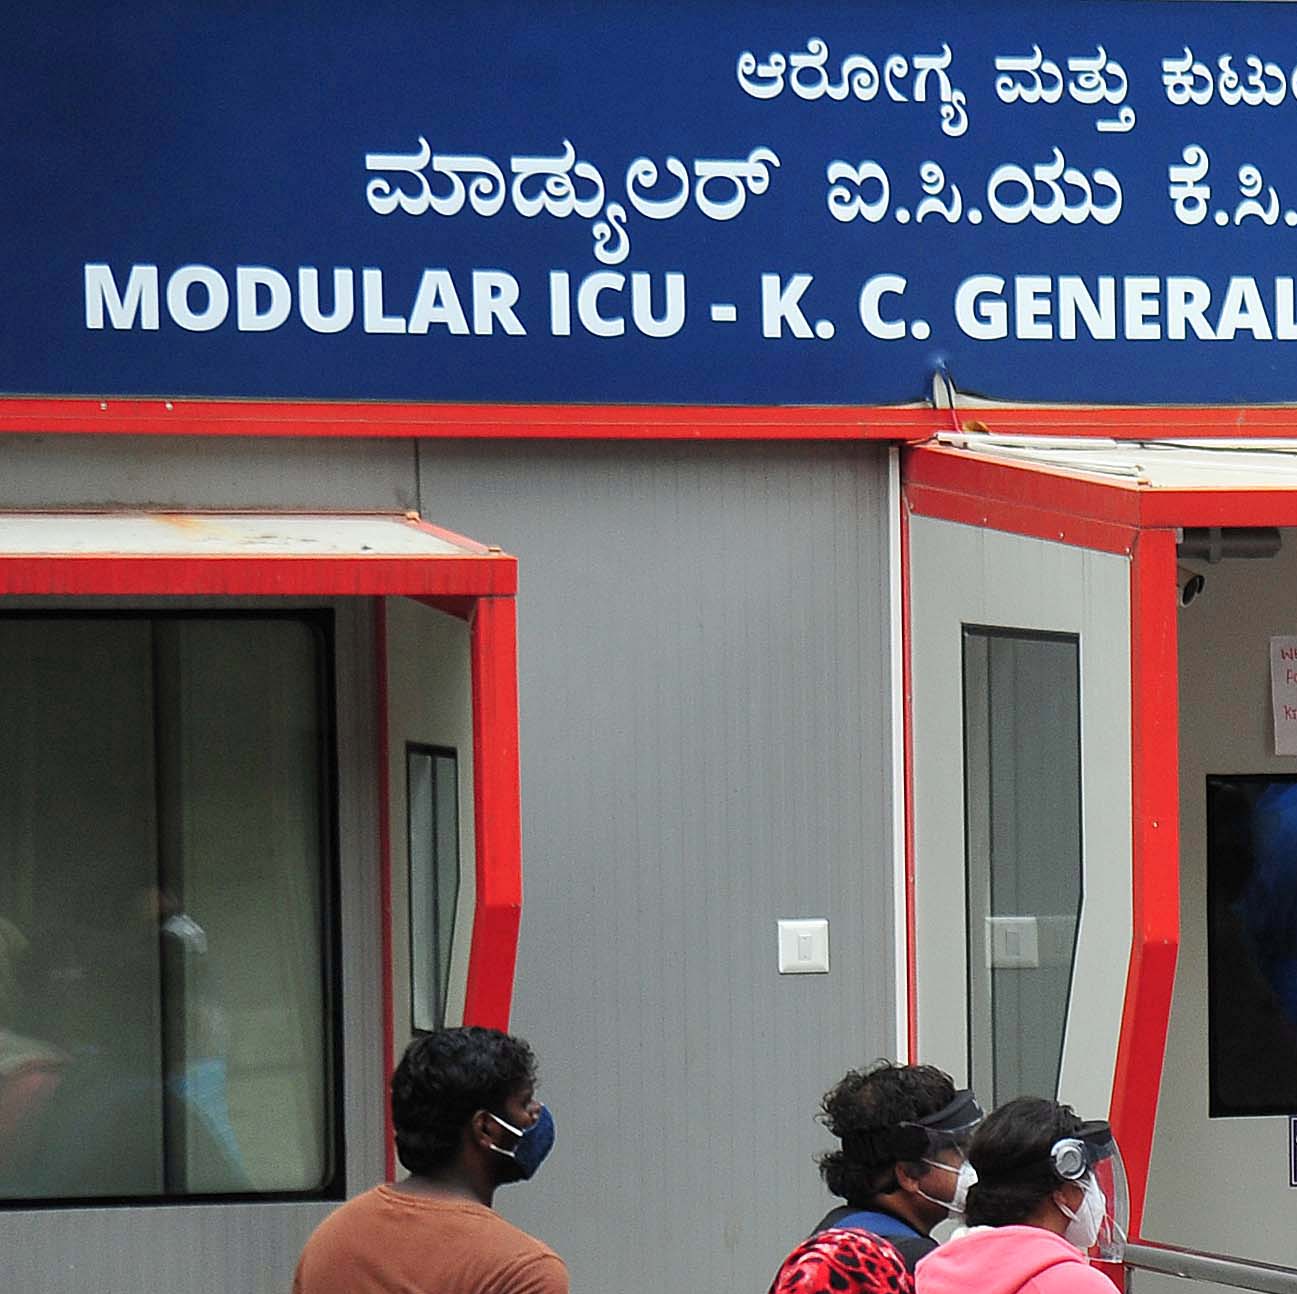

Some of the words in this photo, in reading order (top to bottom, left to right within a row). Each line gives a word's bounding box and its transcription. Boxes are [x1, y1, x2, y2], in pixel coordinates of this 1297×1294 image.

[737, 39, 969, 137] ಆರೋಗ್ಯ
[995, 44, 1136, 132] ಮತ್ತು
[365, 136, 781, 265] ಮಾಡ್ಯುಲರ್
[827, 147, 1123, 225] ಐ.ಸಿ.ಯು
[84, 264, 527, 336] MODULAR
[550, 271, 686, 338] ICU
[711, 305, 737, 322] -
[761, 274, 835, 339] K.
[859, 275, 931, 340] C.
